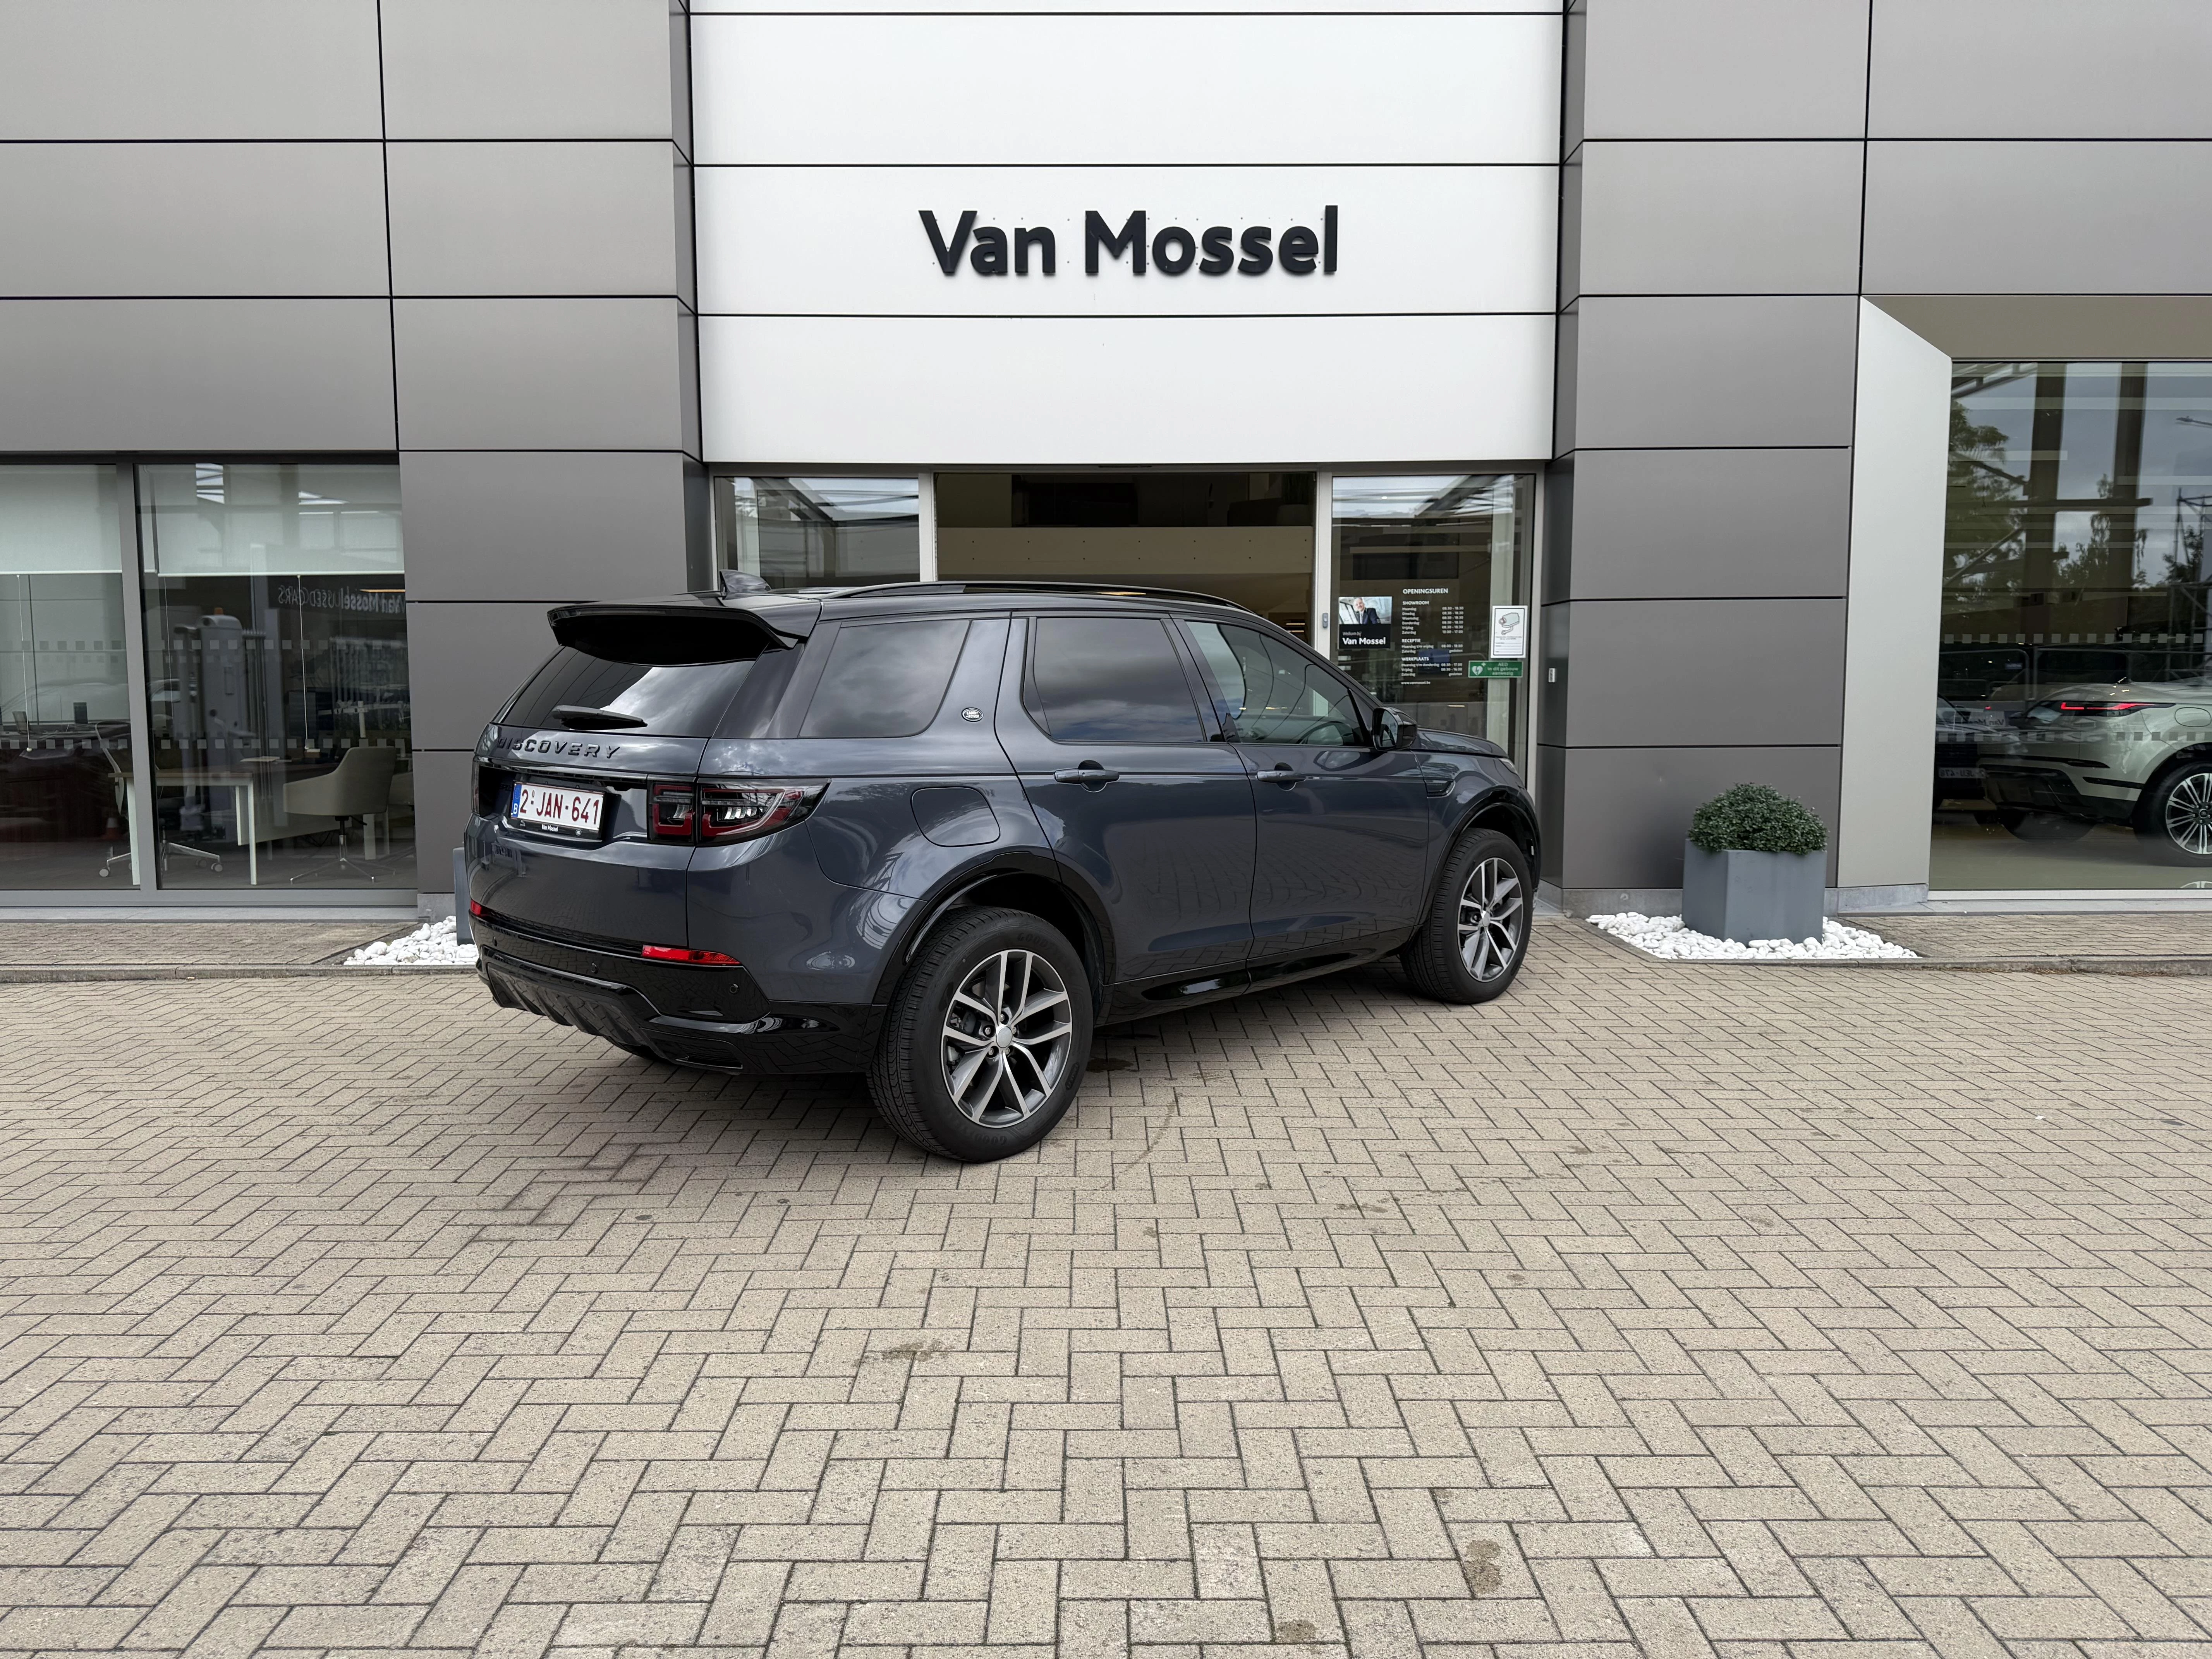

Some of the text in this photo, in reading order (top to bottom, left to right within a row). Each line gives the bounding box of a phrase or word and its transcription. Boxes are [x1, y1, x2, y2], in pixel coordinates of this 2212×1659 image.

[918, 205, 1338, 275] Van Mossel
[1359, 637, 1386, 645] Mossel
[497, 738, 620, 759] DISCOVERY
[513, 803, 518, 814] B
